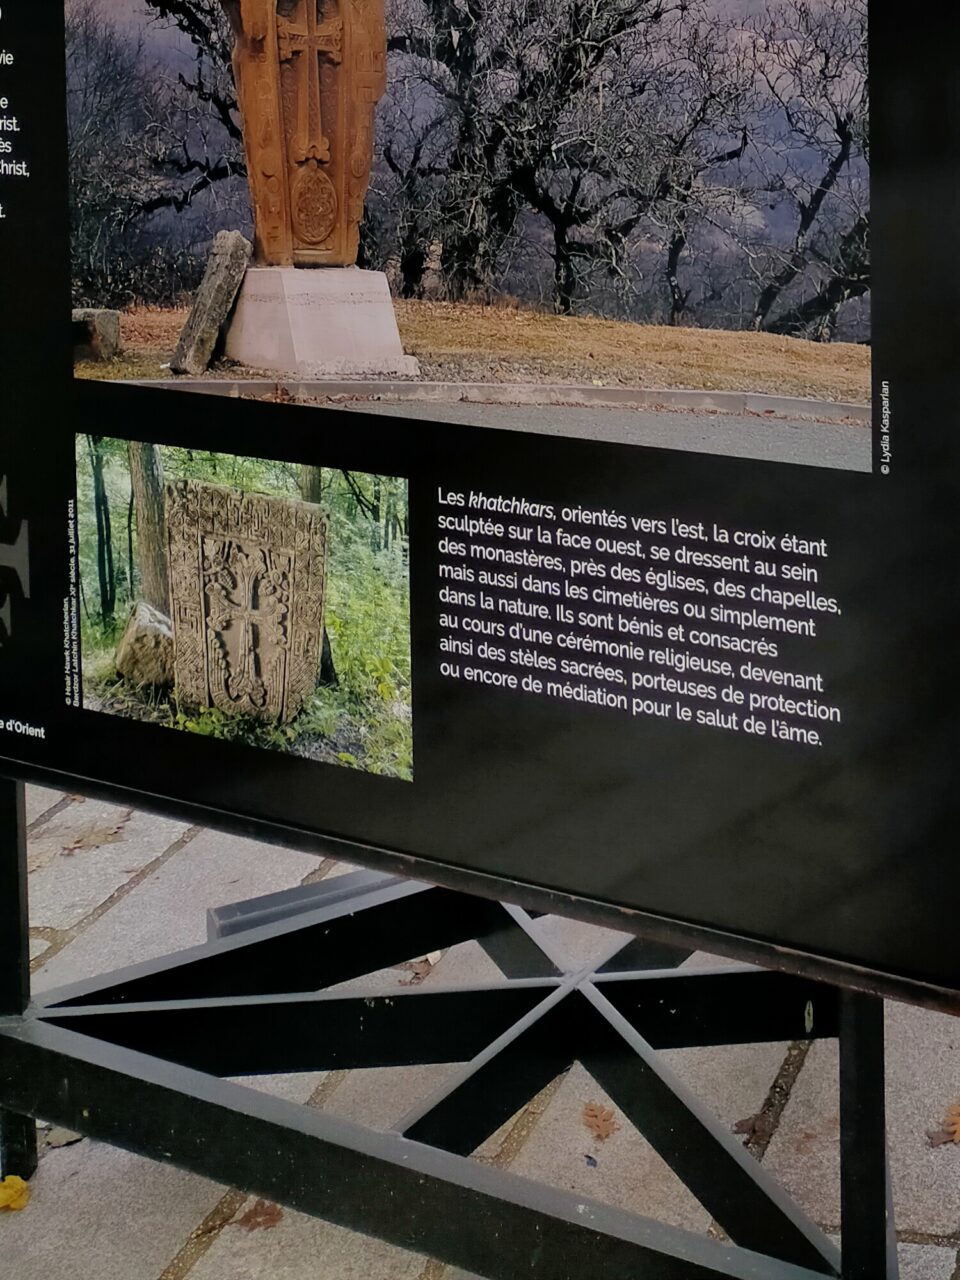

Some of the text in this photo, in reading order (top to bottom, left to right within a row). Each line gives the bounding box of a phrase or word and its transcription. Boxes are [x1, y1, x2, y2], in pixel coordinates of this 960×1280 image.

[0, 159, 30, 177] hrist,
[880, 380, 891, 433] Kasparian
[880, 435, 892, 462] Lydia
[438, 487, 828, 557] Les khatchkars, orientés vers l'est, la croix étant
[438, 515, 818, 583] sculptée sur la face ouest, se dressent au sein
[438, 537, 841, 615] des monastères, près des églises, des chapelles,
[439, 564, 816, 637] mais aussi dans les cimetières ou simplement
[439, 586, 778, 657] dans la nature. Ils sont bénis et consacrés
[439, 613, 824, 692] au cours d'une cérémonie religieuse, devenant
[440, 635, 840, 722] ainsi des stèles sacrées, porteuses de protection
[440, 663, 822, 746] ou encore de médiation pour le salut de l'âme.
